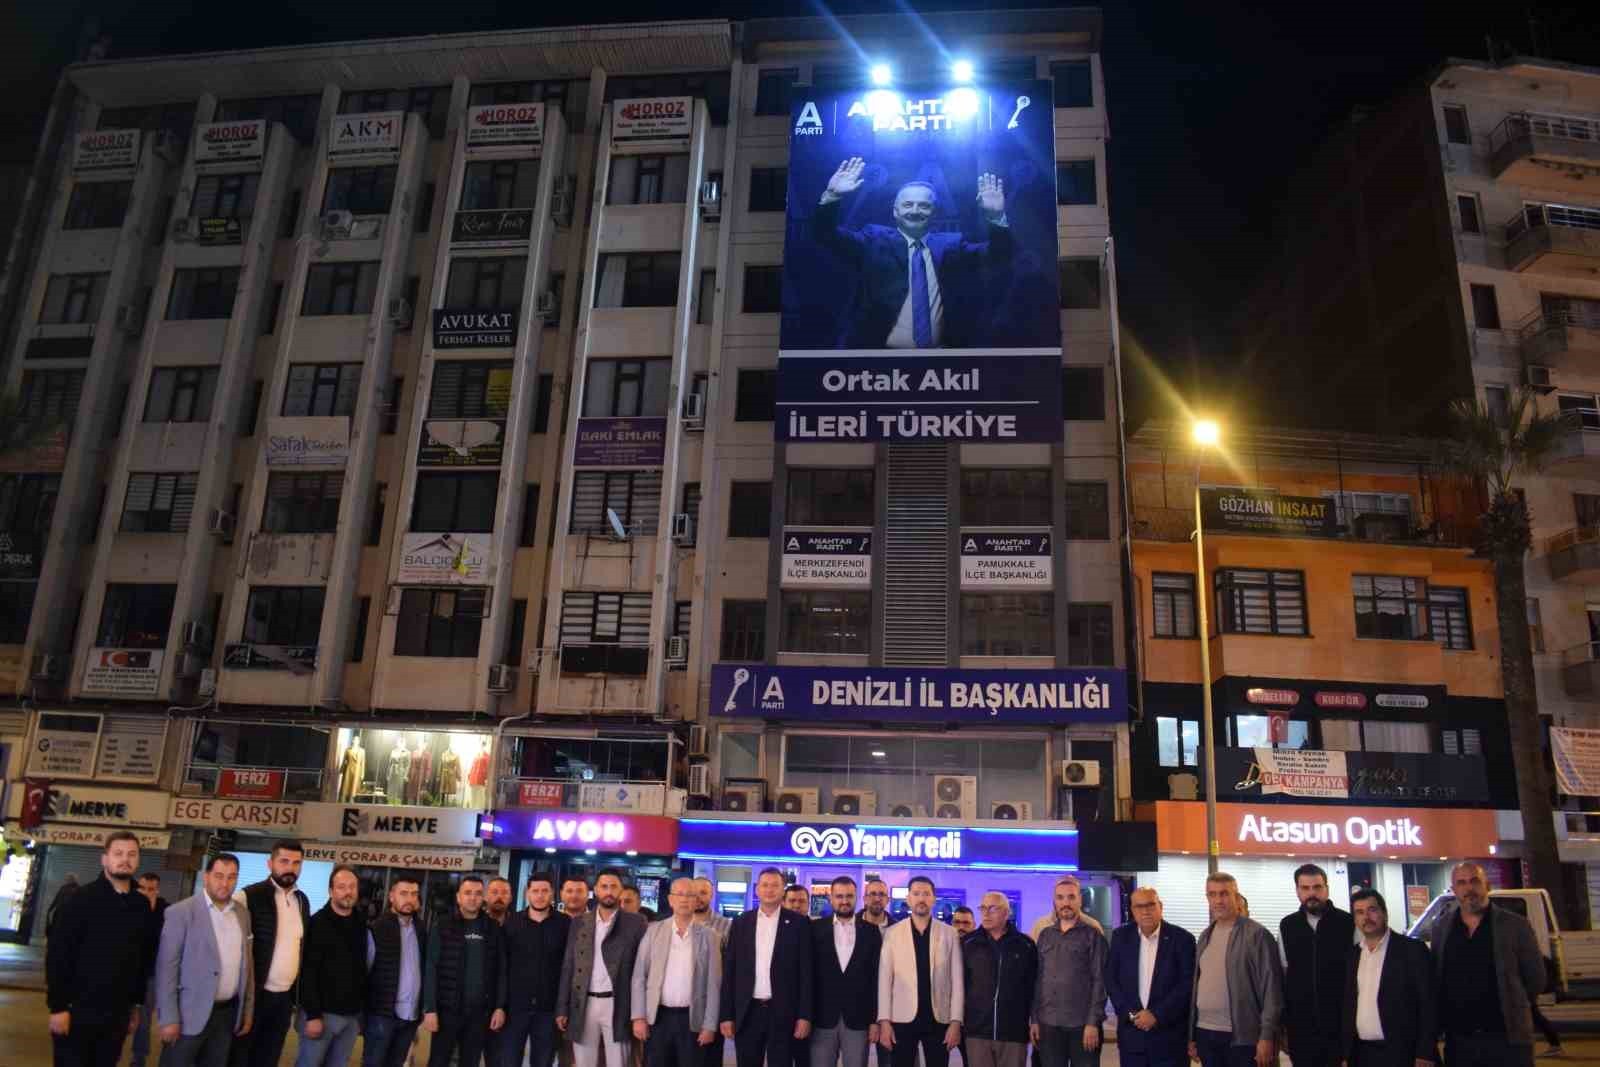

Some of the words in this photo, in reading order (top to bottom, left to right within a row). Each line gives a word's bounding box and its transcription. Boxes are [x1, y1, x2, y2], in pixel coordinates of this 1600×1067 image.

[629, 101, 685, 115] HOROZ
[796, 101, 823, 127] A
[340, 120, 393, 138] AKM
[440, 313, 512, 329] AVUKAT
[822, 369, 911, 392] Ortak
[918, 368, 980, 392] Akıl
[789, 410, 867, 438] İLERİ
[877, 410, 1017, 438] TÜRKİYE
[977, 560, 1037, 569] PAMUKKALE
[762, 676, 784, 701] A
[812, 676, 912, 707] DENİZLİ
[919, 677, 944, 708] İL
[950, 677, 1110, 716] BAŞKANLIĞI
[70, 801, 126, 818] MERVE
[174, 801, 212, 820] EGE
[374, 815, 438, 834] MERVE
[533, 818, 625, 843] AVON
[1238, 814, 1339, 844] Atasun
[1345, 816, 1422, 851] Optik
[51, 831, 92, 842] ÇORAP
[849, 828, 961, 861] YapıKredi
[341, 851, 386, 864] ÇORAP
[389, 854, 401, 864] &
[403, 855, 463, 868] ÇAMAŞIR
